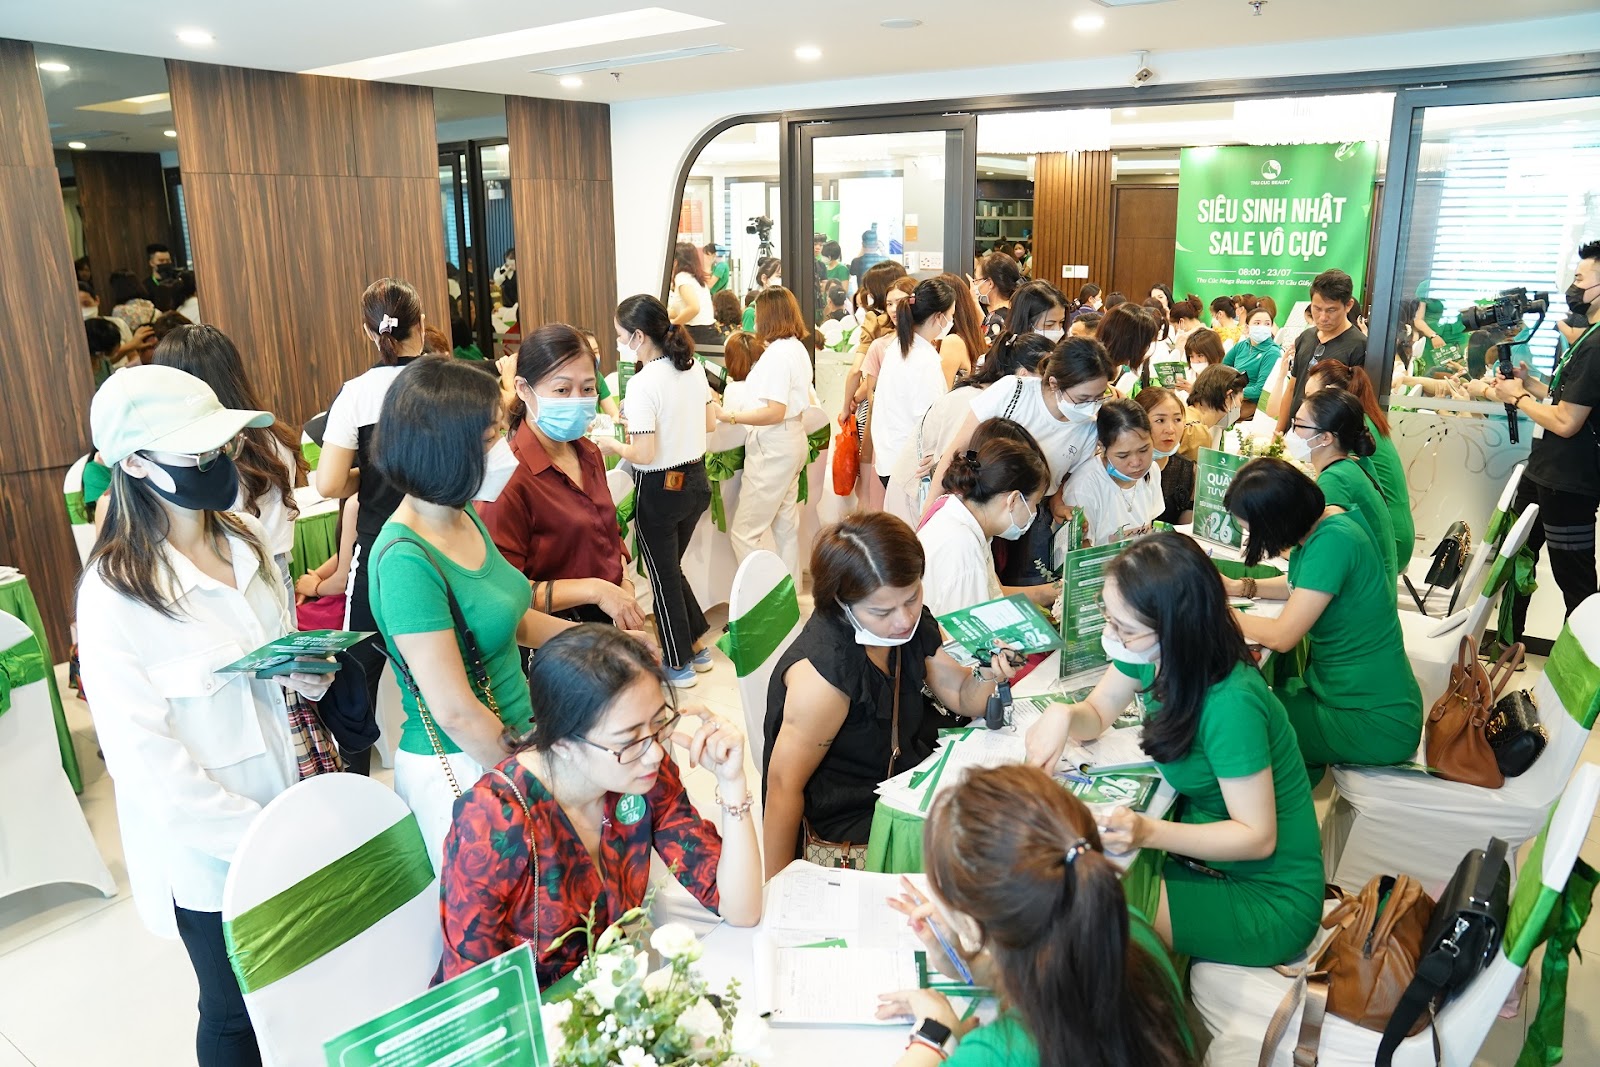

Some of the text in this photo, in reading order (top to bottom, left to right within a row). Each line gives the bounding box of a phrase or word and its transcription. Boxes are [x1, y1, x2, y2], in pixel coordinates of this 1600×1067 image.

[1198, 193, 1347, 228] SIÊU SINH NHẬT
[1208, 227, 1328, 261] SALE VÔ CỰC
[1238, 268, 1260, 276] 08:00
[1266, 268, 1292, 276] 23/07
[1210, 512, 1232, 544] 26
